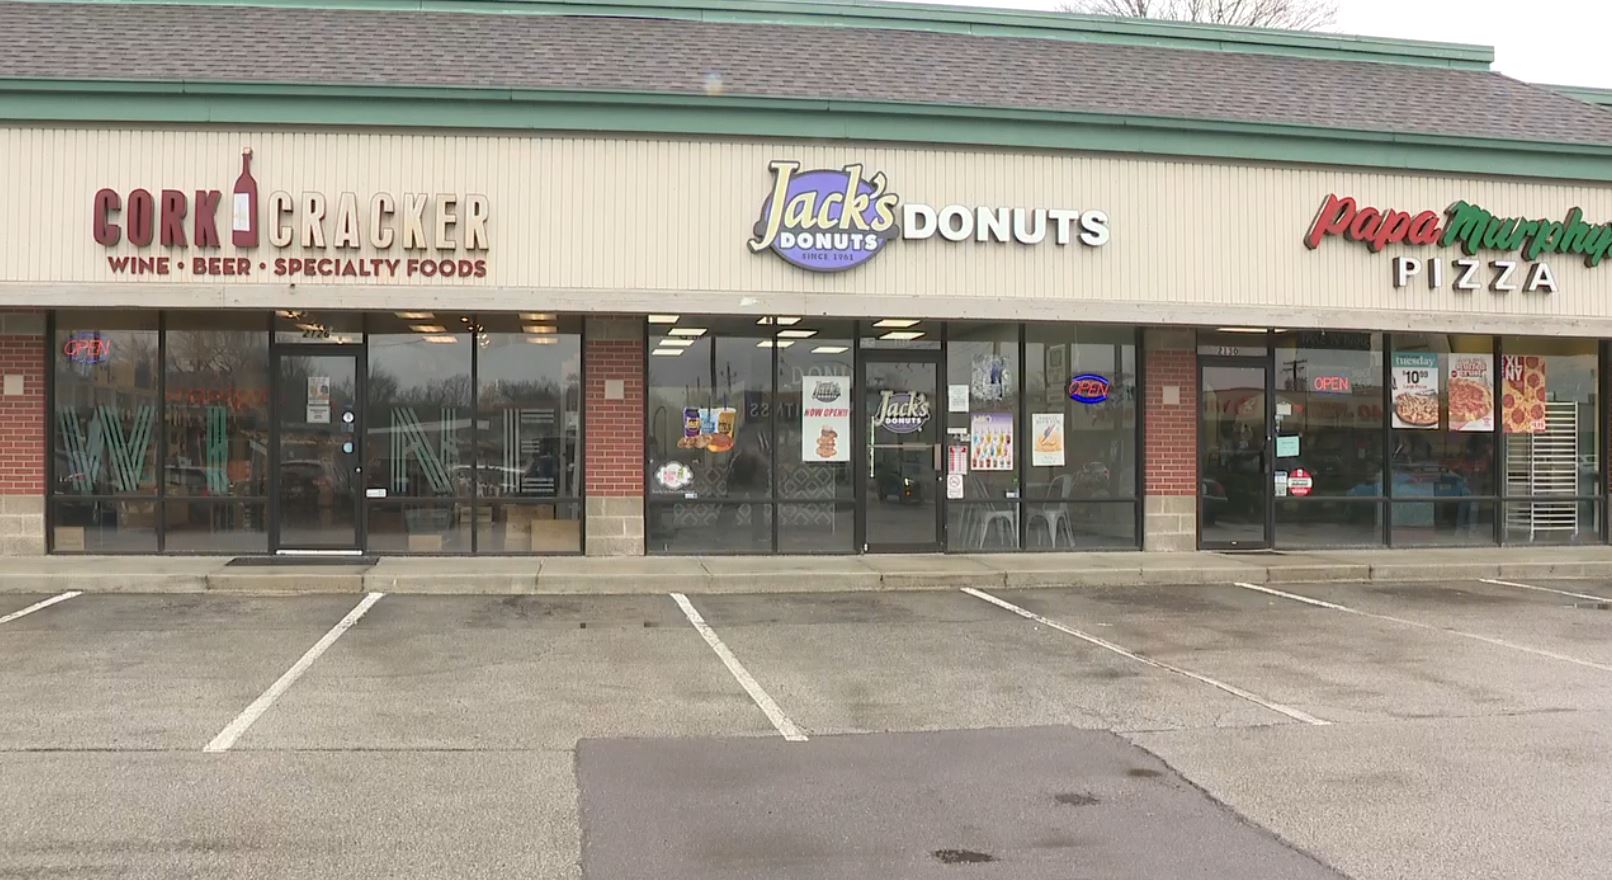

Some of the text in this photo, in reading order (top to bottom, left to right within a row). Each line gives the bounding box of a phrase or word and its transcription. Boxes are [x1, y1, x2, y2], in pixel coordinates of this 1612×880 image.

[747, 160, 900, 254] Jack's
[93, 187, 490, 250] CORK CRACKER
[900, 203, 1111, 248] DONUTS
[779, 231, 879, 251] DONUTS
[108, 256, 488, 279] WINE BEER SPECIALTY FOODS
[1392, 256, 1560, 293] PIZZA
[63, 337, 112, 358] OPEN
[1396, 355, 1433, 367] tuesday
[1505, 355, 1523, 367] XL
[1068, 380, 1110, 398] OPEN
[1314, 376, 1350, 391] OPEN
[804, 408, 823, 417] NOW
[874, 390, 930, 427] Jack's
